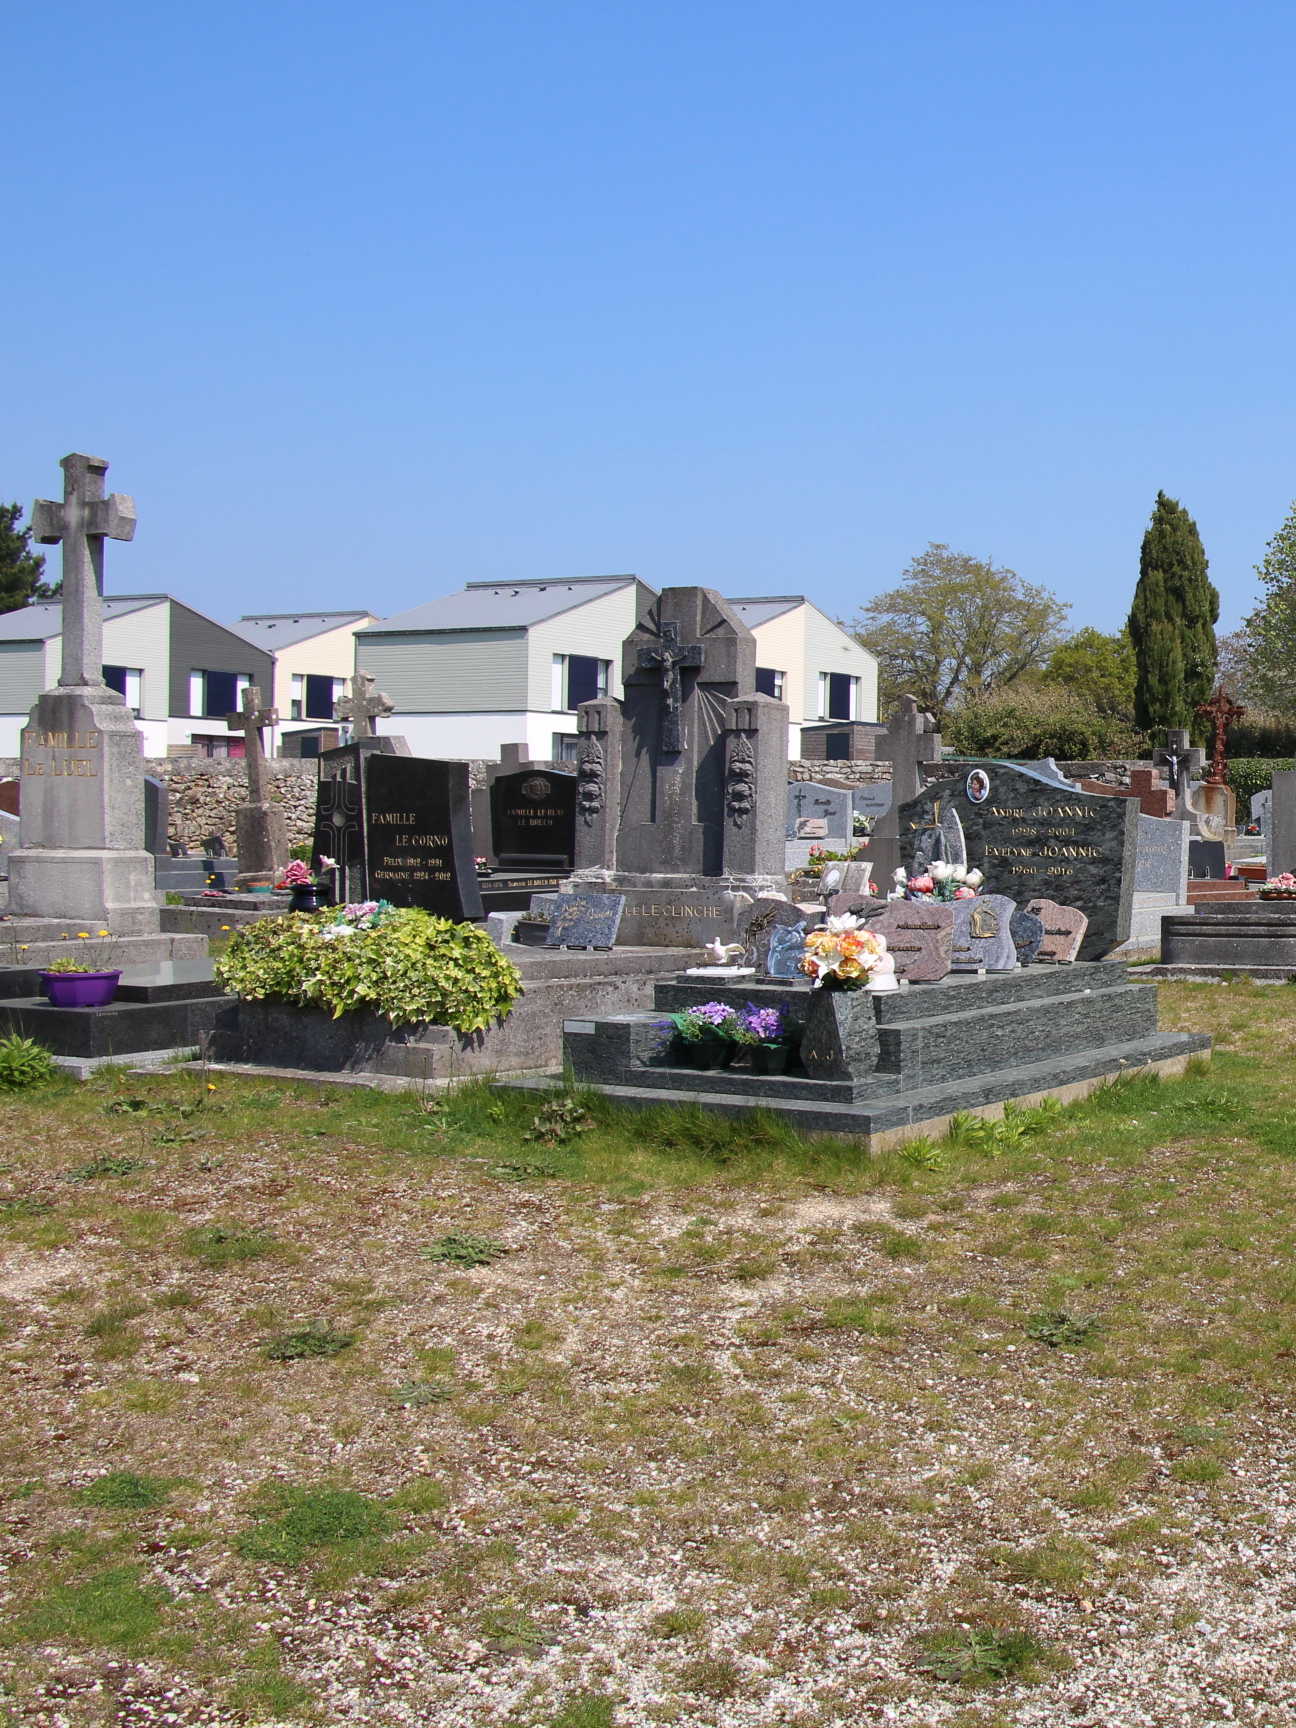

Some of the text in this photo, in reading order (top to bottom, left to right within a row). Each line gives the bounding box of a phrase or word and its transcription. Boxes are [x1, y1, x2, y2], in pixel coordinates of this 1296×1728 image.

[24, 730, 98, 749] FAMILLE
[51, 758, 99, 777] LUEL
[507, 808, 535, 816] FAMILLE
[1032, 806, 1100, 818] JOANNIC
[371, 813, 416, 825] FAMILLE
[517, 818, 553, 826] LE BRECH
[395, 834, 448, 848] LE CORNO
[1039, 845, 1103, 858] JOANNIC
[374, 869, 410, 879] GERMAINE
[1011, 865, 1037, 875] 1960
[1046, 866, 1074, 876] 2016
[641, 903, 660, 916] LE
[662, 904, 722, 918] CLINCHE
